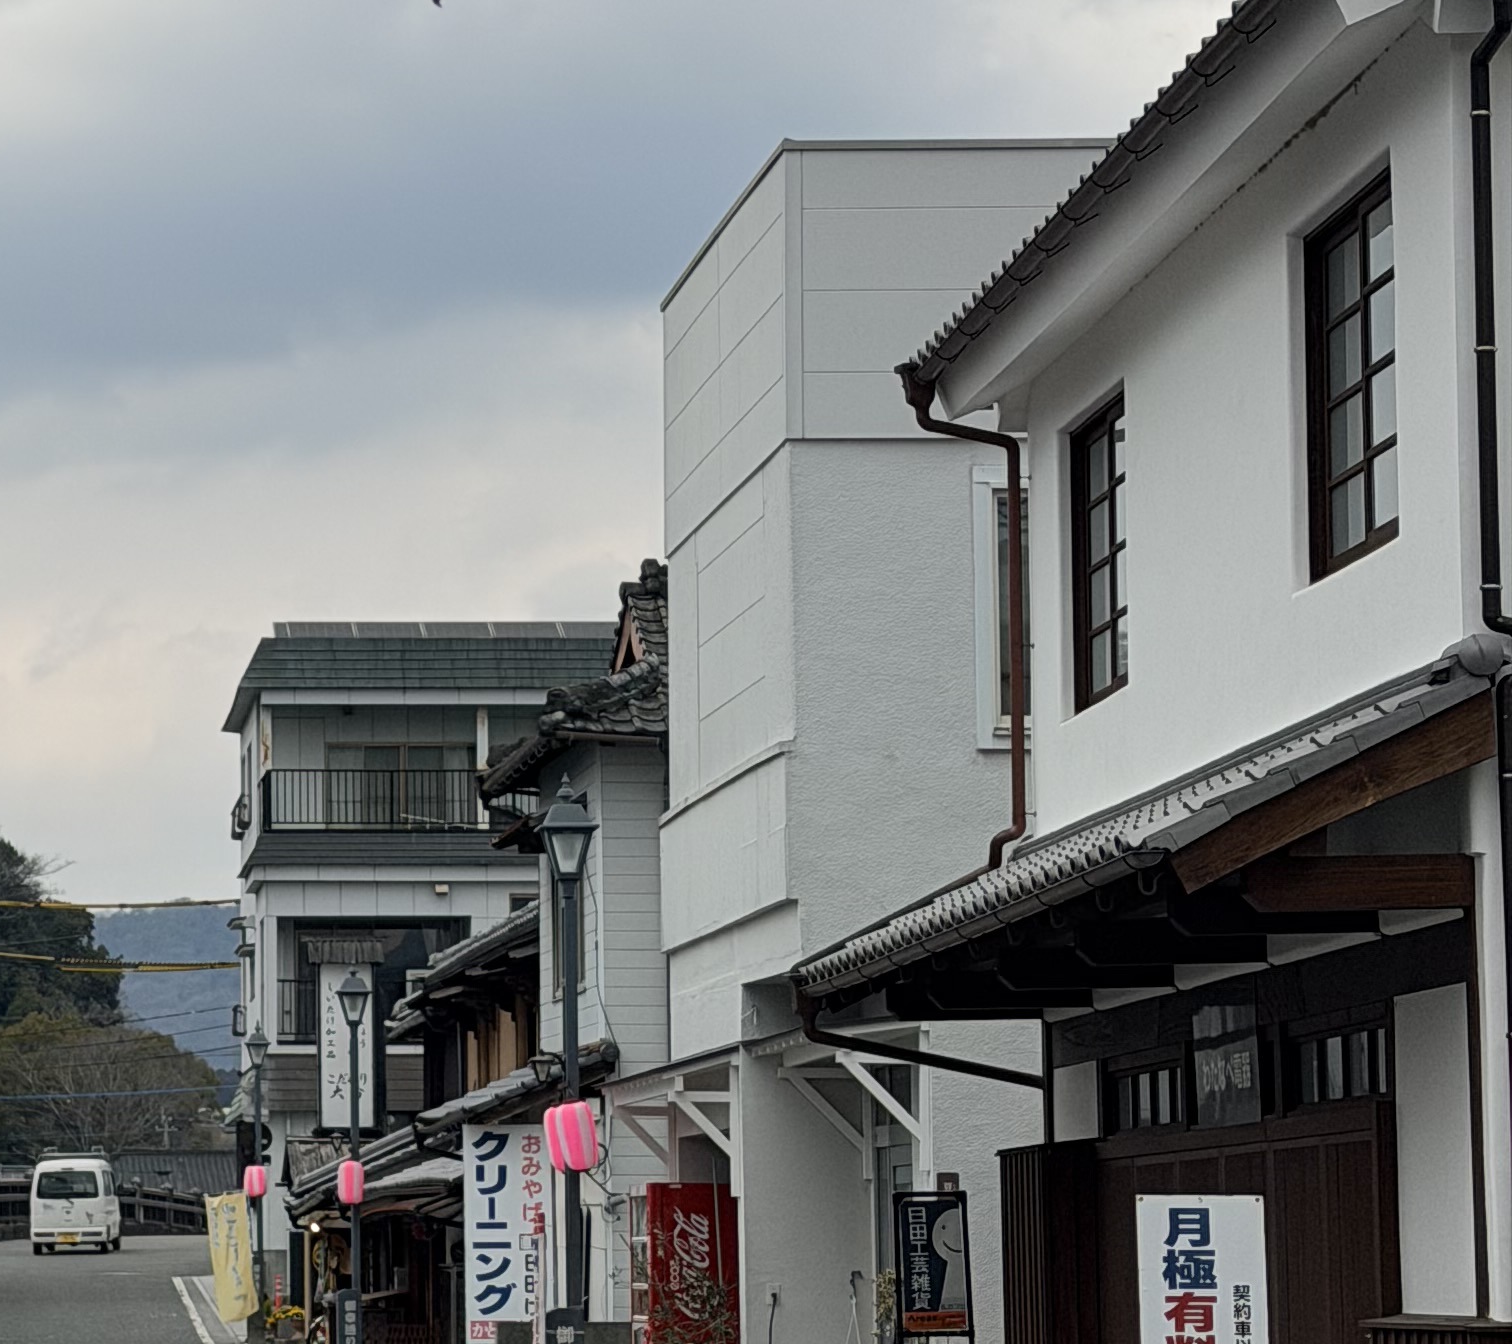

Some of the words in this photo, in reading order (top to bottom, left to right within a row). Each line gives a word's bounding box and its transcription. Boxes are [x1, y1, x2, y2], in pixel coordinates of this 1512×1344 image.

[327, 1072, 367, 1086] こだり
[472, 1131, 517, 1316] クリーニング
[673, 1205, 709, 1321] Ca-Cola
[908, 1206, 932, 1310] 日田工芸雑貨
